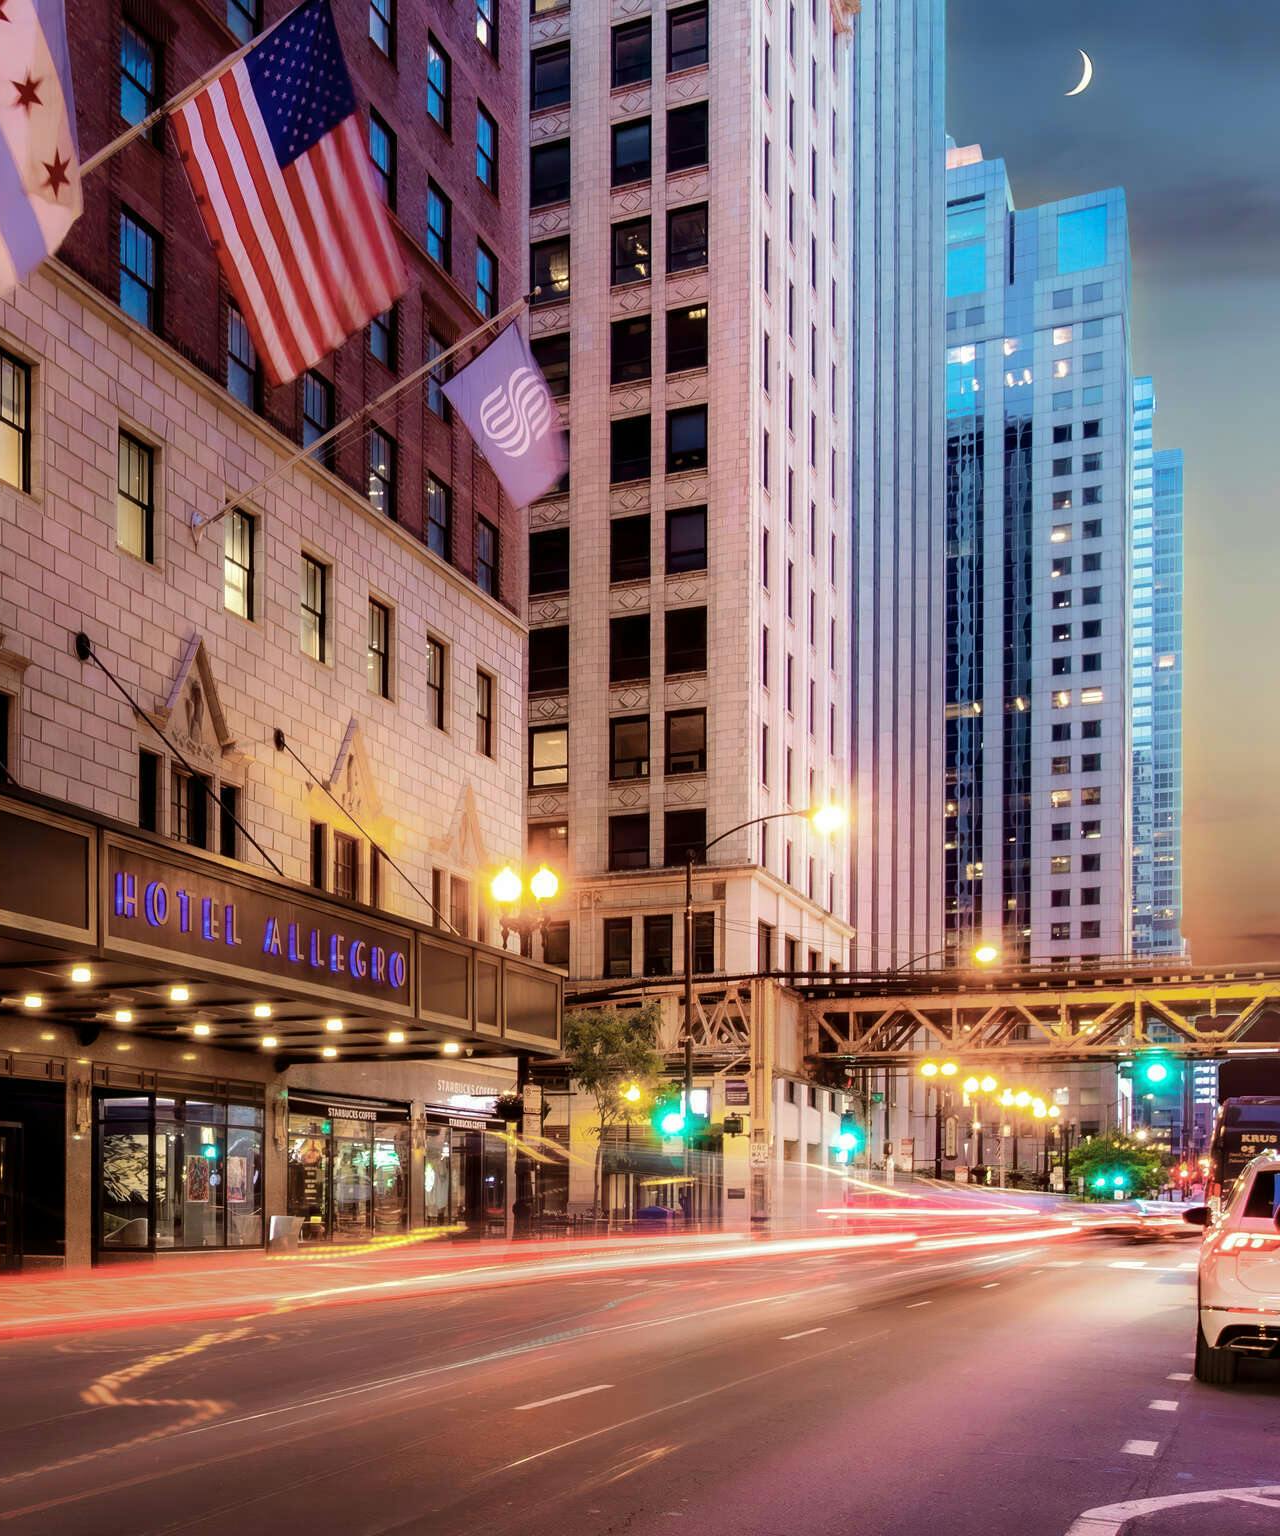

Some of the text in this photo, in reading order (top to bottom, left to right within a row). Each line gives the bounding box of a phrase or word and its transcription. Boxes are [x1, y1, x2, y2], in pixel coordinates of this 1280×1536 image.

[114, 871, 406, 988] HOTEL ALLEGRO
[437, 1079, 475, 1095] STARBUCKS
[327, 1107, 377, 1120] STARBUCKS COFFEE
[449, 1117, 487, 1130] STARBUCKS COFFEE
